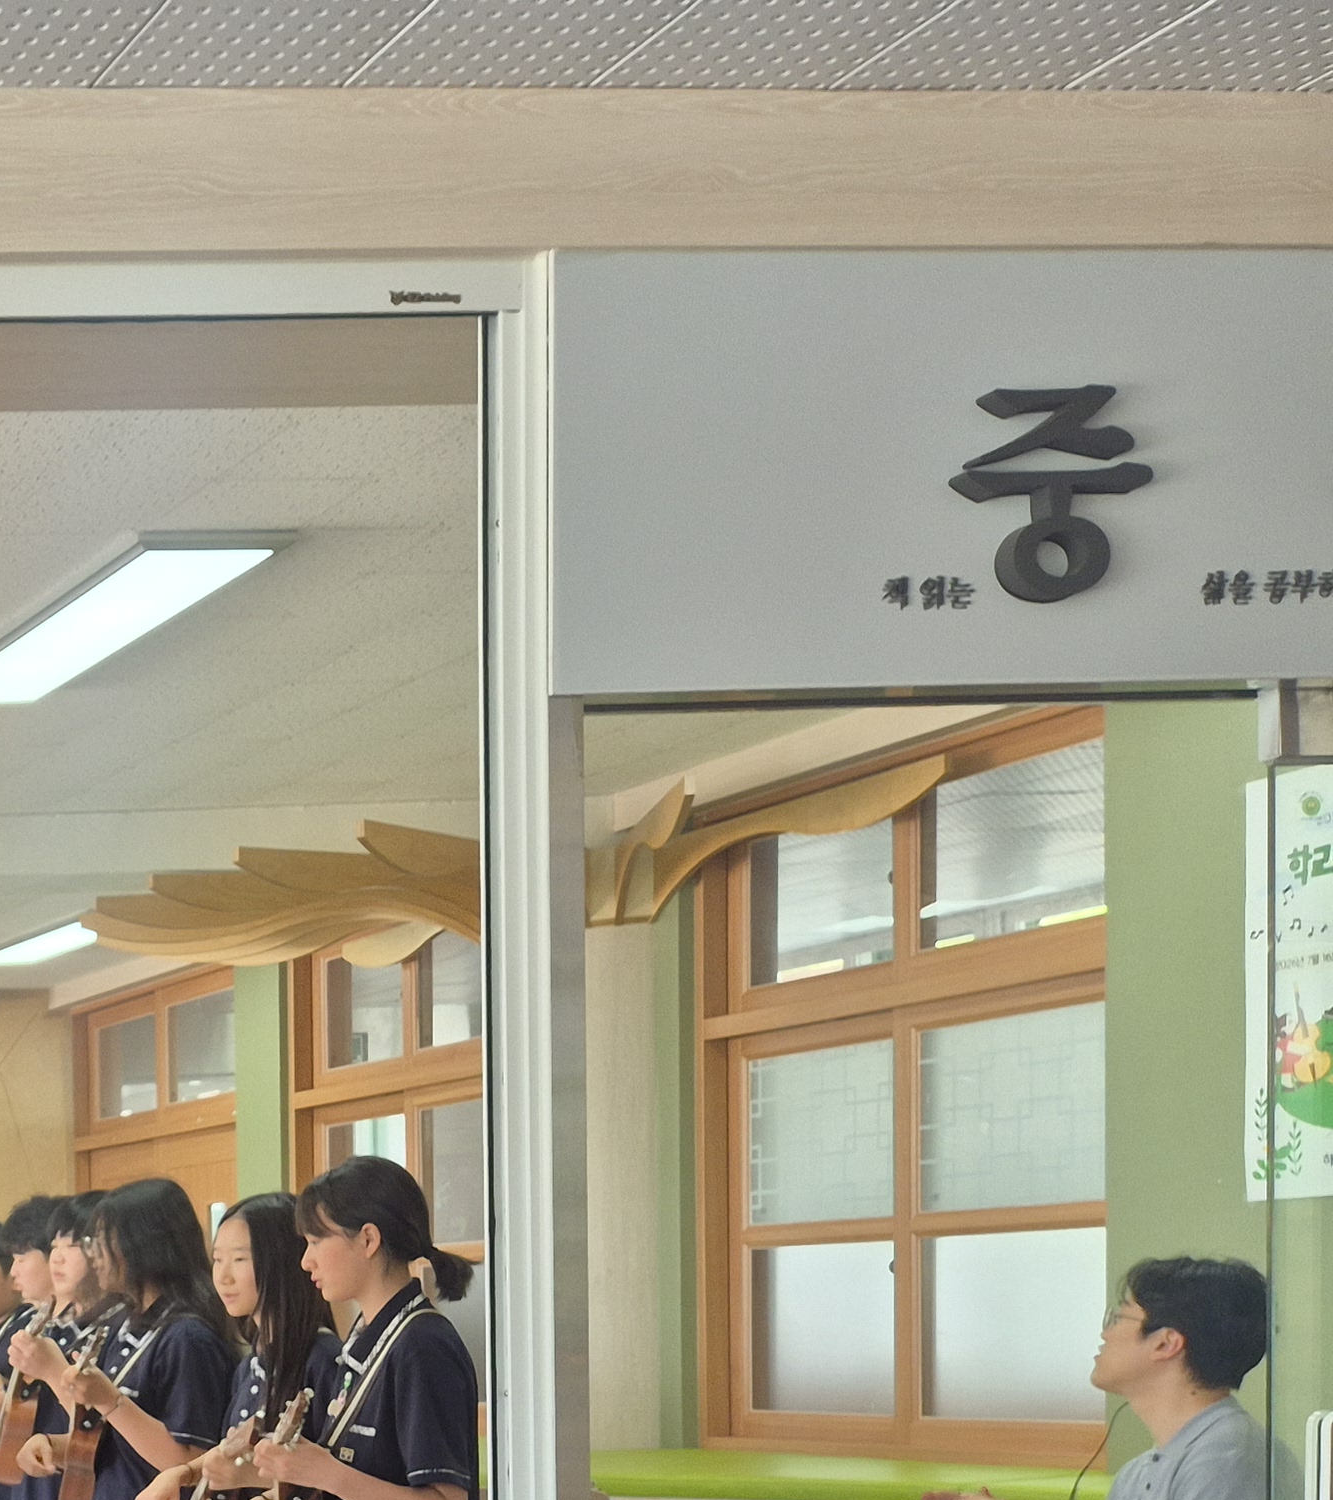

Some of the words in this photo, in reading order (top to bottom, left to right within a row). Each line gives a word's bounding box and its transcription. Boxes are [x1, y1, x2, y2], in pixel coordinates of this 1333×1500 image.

[947, 384, 1155, 604] 중
[882, 575, 910, 611] 책
[919, 575, 976, 611] 읽는
[1201, 569, 1256, 606] 삶을
